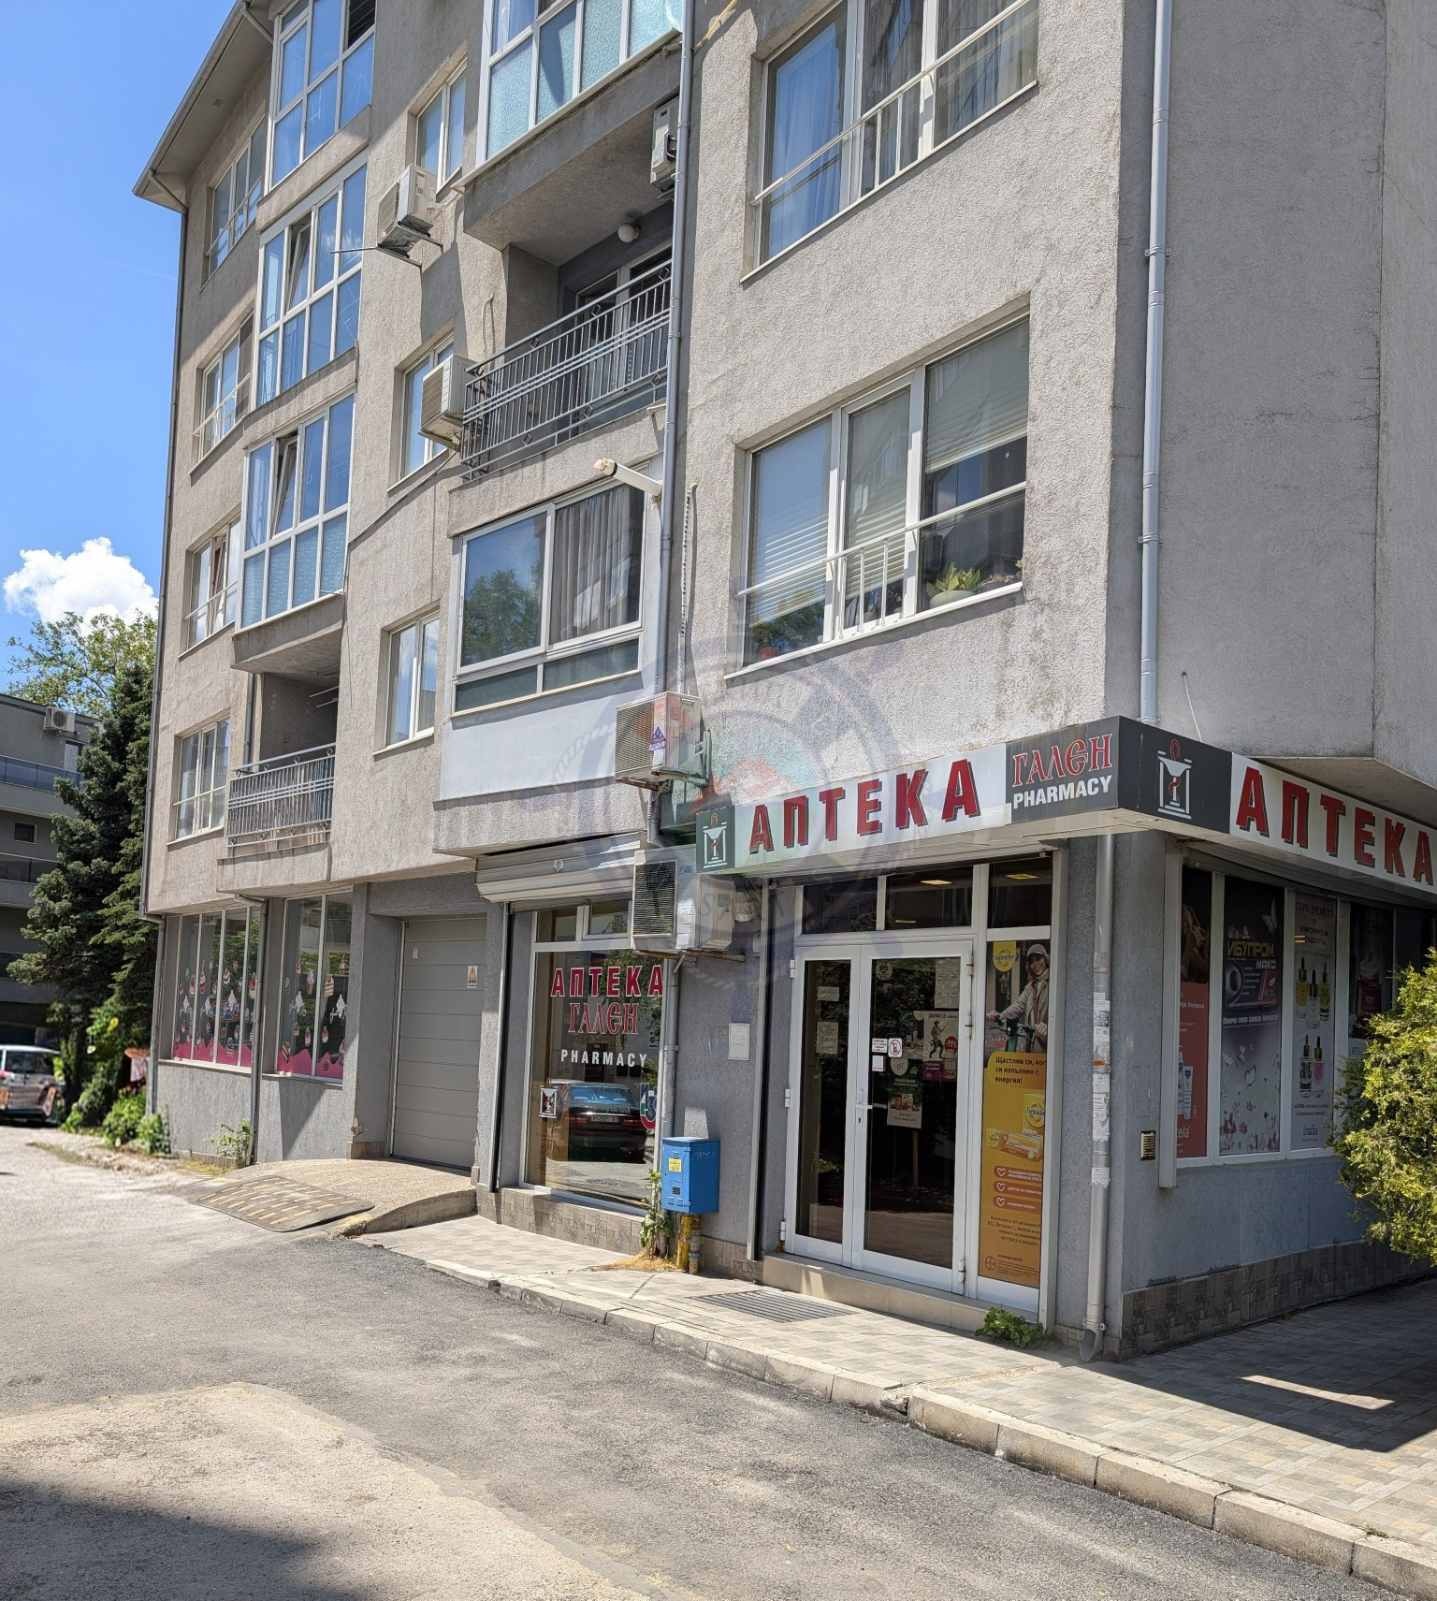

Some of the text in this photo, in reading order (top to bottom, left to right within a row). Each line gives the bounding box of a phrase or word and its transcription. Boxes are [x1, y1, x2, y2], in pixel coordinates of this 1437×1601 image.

[750, 758, 981, 854] АПТЕКА
[1013, 775, 1112, 809] PHARMACY
[1236, 766, 1434, 886] АПТЕКА
[551, 965, 663, 997] АПТЕКА
[561, 1048, 647, 1068] PHARMACY
